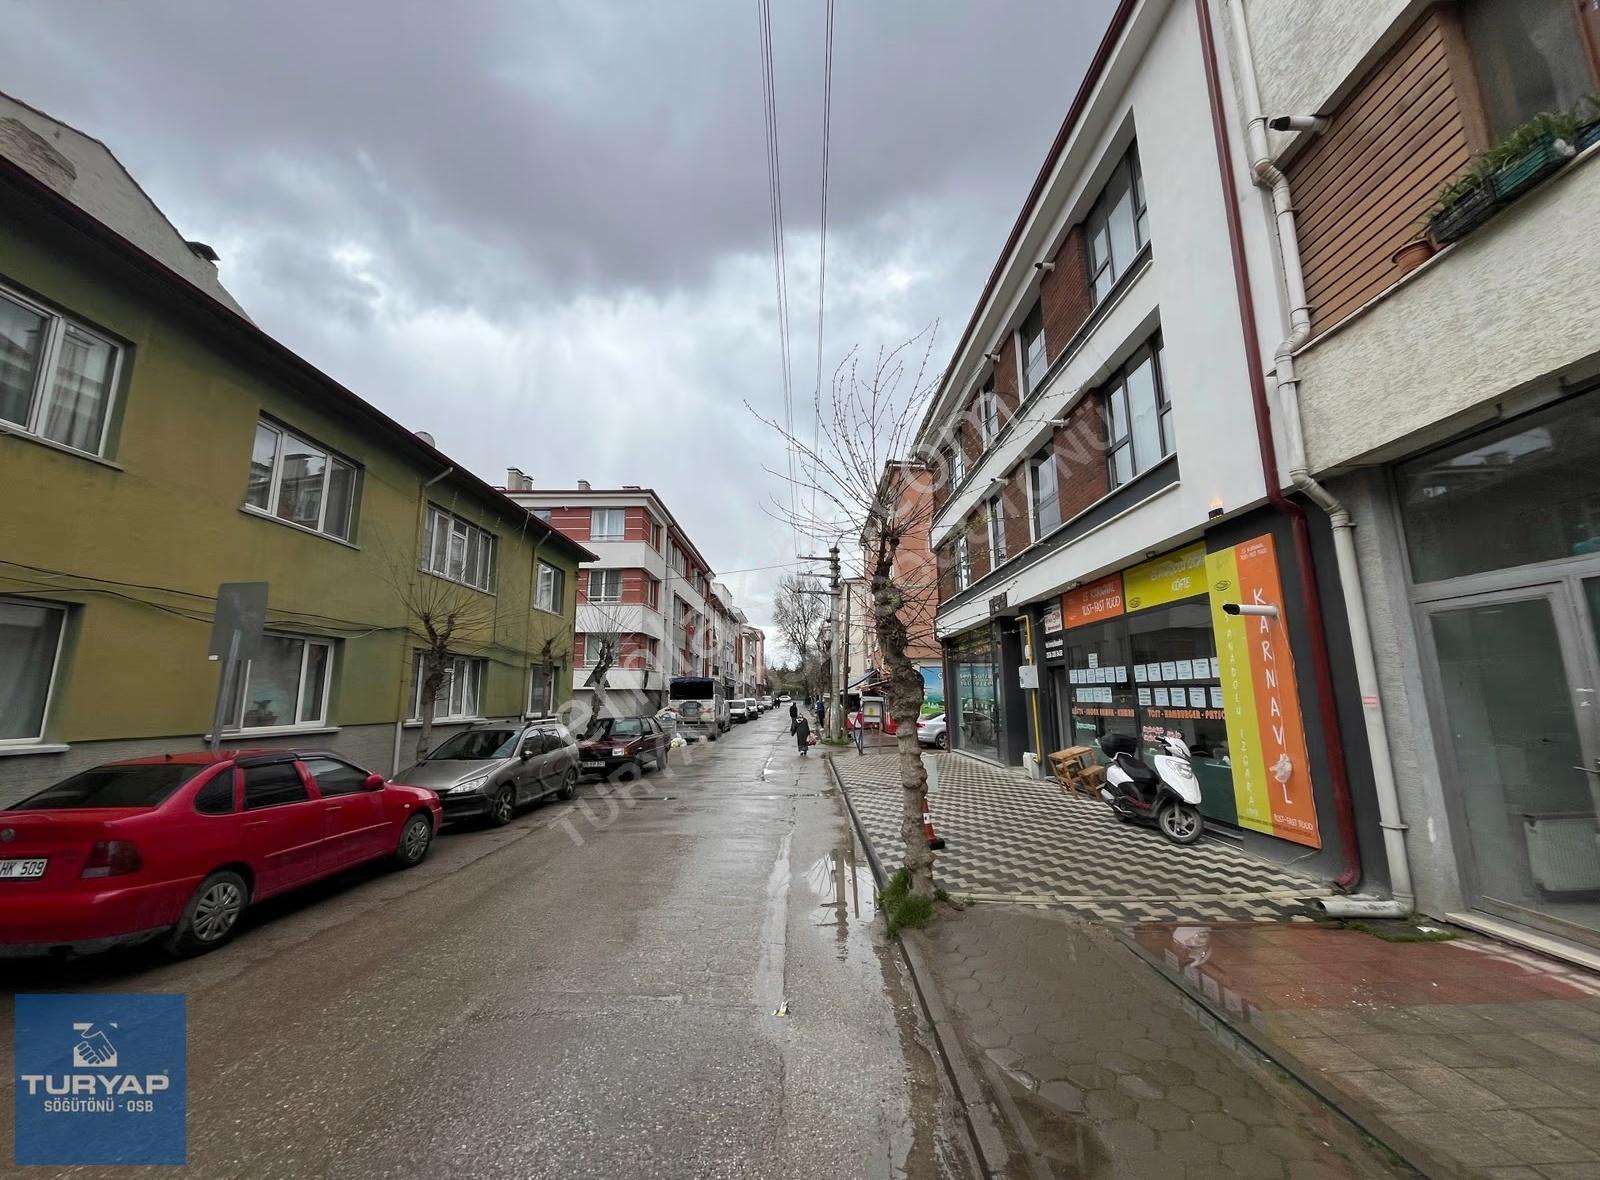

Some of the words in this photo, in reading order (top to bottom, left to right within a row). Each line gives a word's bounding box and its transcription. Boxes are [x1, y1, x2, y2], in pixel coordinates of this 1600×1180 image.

[1106, 595, 1121, 609] FOOD
[1253, 587, 1293, 805] KARNAVL
[20, 861, 45, 876] 509
